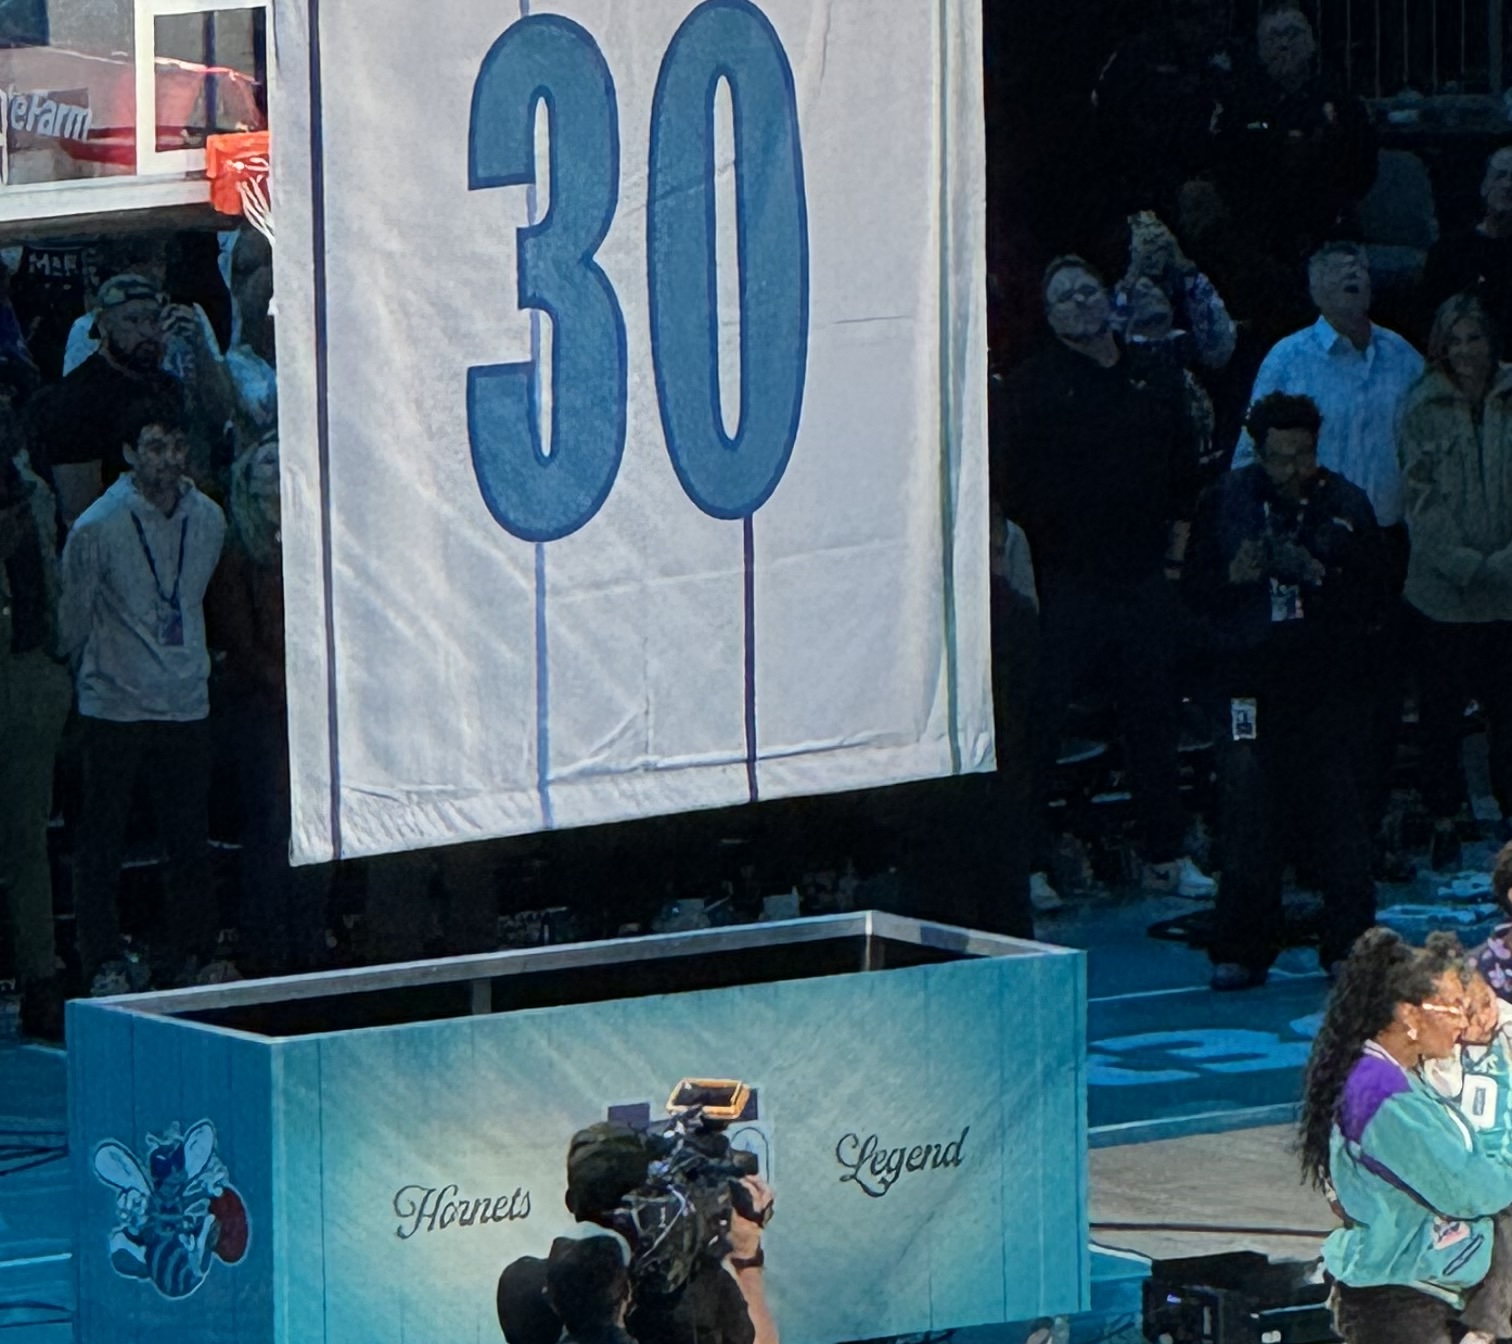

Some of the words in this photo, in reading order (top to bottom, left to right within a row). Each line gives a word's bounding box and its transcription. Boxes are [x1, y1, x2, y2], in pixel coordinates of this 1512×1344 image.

[8, 88, 92, 142] eFarm
[836, 1126, 970, 1197] Legend
[393, 1184, 531, 1239] Hornets
